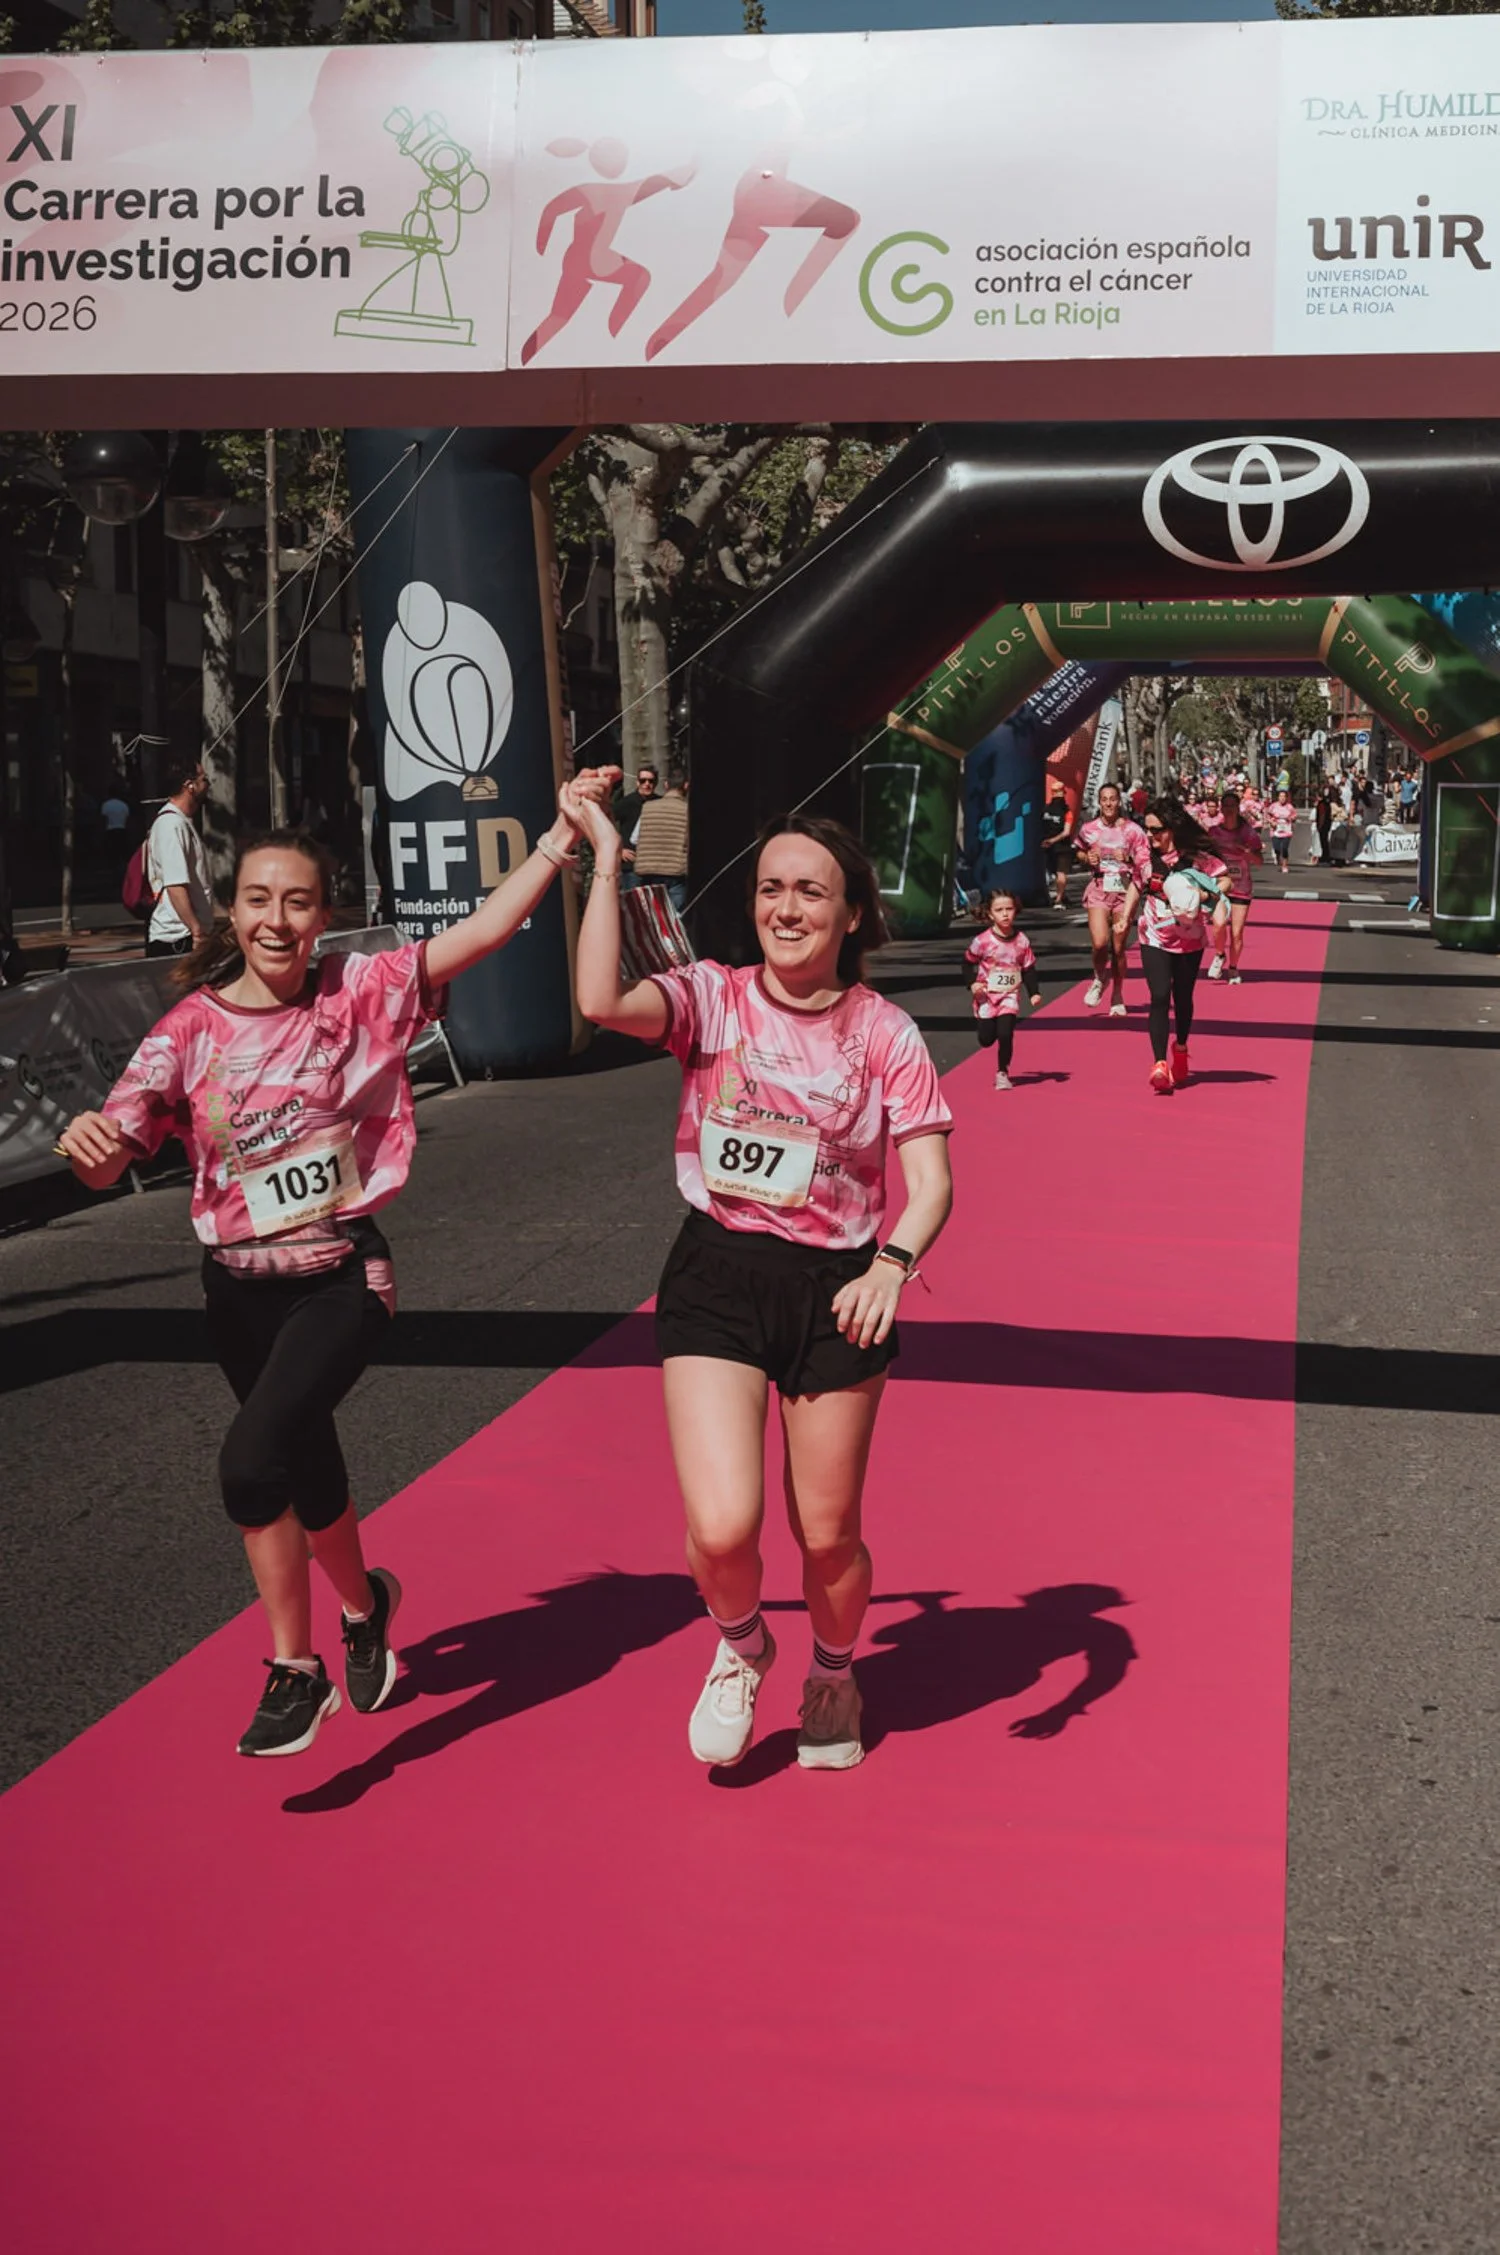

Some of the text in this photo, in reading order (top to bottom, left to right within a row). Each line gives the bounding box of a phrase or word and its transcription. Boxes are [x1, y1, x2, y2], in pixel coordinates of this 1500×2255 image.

[1301, 97, 1368, 121] DRA.
[6, 104, 76, 162] XI
[1350, 123, 1500, 139] CLÍNICA MEDICIN
[4, 174, 365, 230] Carrera por la
[1, 234, 350, 292] investigación
[975, 235, 1250, 265] asociación española
[975, 268, 1193, 293] contra el cáncer
[1307, 268, 1408, 283] UNIVERSIDAD
[1306, 284, 1430, 299] INTERNACIONAL
[0, 295, 97, 331] 2026
[974, 301, 1121, 330] en La Rioja
[1306, 301, 1396, 315] DE LA RIOJA
[917, 627, 1026, 721] PITILLOS
[1341, 630, 1442, 738] PITILLOS
[1035, 667, 1087, 717] nuestra
[1083, 720, 1113, 802] aixaBank
[389, 817, 528, 891] FFD
[395, 897, 470, 915] Fundación
[432, 920, 447, 935] el
[997, 975, 1016, 986] 236
[230, 1098, 303, 1129] Carrera
[735, 1100, 804, 1125] Carrera
[236, 1125, 289, 1156] por la
[719, 1137, 785, 1179] 897
[264, 1154, 343, 1205] 1031
